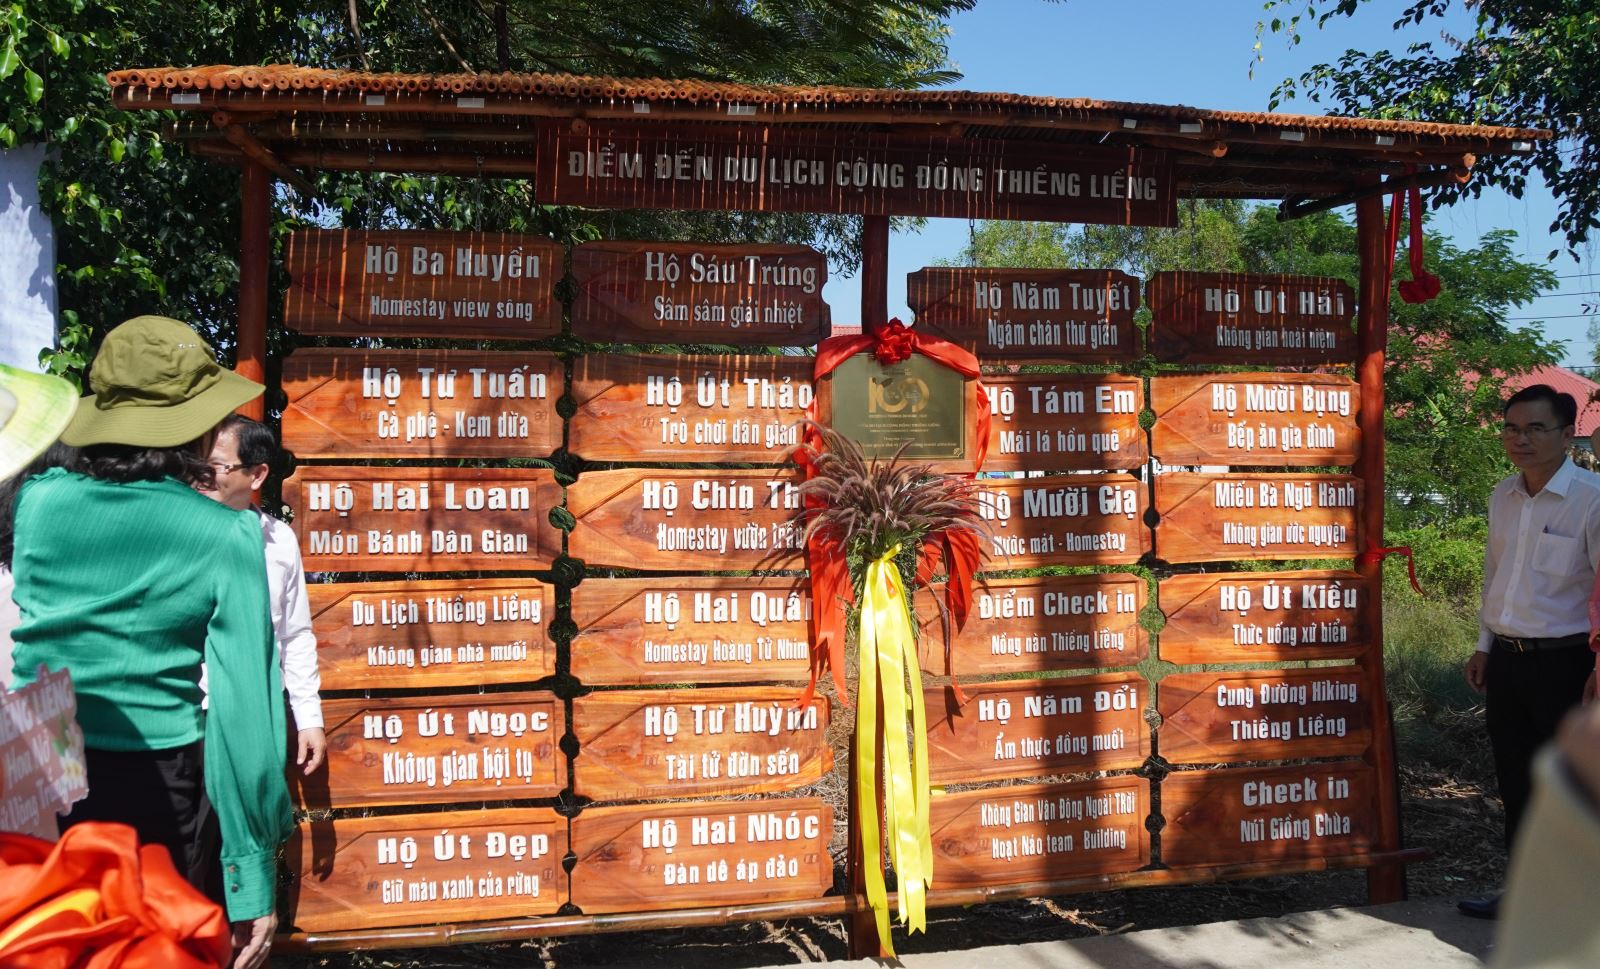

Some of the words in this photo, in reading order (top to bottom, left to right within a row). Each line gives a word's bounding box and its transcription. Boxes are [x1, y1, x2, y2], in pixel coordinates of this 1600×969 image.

[569, 144, 643, 179] ĐIỂM
[655, 148, 713, 181] ĐẾN
[724, 155, 757, 184] DU
[769, 158, 825, 186] LỊCH
[835, 158, 904, 194] CỘNG
[916, 158, 984, 193] ĐỒNG
[997, 164, 1081, 198] THIỀNG
[1090, 170, 1157, 201] LIỀNG
[366, 246, 398, 281] Hộ
[413, 247, 444, 276] Ba
[457, 247, 539, 282] Huyền
[645, 251, 680, 288] Hộ
[690, 253, 735, 284] Sáu
[745, 256, 816, 294] Trúng
[371, 296, 446, 320] Homestay
[453, 298, 490, 318] view
[497, 299, 533, 321] sông
[654, 296, 688, 321] Sâm
[694, 299, 725, 321] sâm
[764, 299, 802, 328] nhiệt
[975, 281, 1001, 315] Hộ
[1012, 282, 1060, 310] Năm
[1069, 279, 1131, 314] Tuyết
[1205, 288, 1239, 318] Hộ
[988, 318, 1024, 349] Ngâm
[1030, 319, 1060, 345] chân
[1067, 321, 1086, 345] thư
[1217, 326, 1251, 349] Không
[1256, 329, 1277, 349] gian
[363, 368, 401, 405] Hộ
[418, 368, 457, 398] Tư
[469, 365, 546, 399] Tuấn
[647, 375, 682, 412] Hộ
[698, 371, 730, 407] Út
[744, 375, 813, 409] Thảo
[1213, 384, 1237, 417] Hộ
[1246, 384, 1294, 412] Mười
[1303, 385, 1349, 417] Bụng
[985, 386, 1014, 421] Hộ
[1028, 386, 1084, 414] Tám
[1096, 386, 1135, 414] Em
[379, 411, 398, 438] Cà
[407, 413, 437, 442] phê
[456, 412, 491, 437] Kem
[498, 411, 528, 438] dừa
[660, 417, 687, 444] Trò
[732, 420, 759, 444] dân
[765, 420, 796, 448] gian
[1000, 430, 1030, 454] Mái
[1037, 430, 1054, 453] lá
[1058, 427, 1085, 452] hồn
[1092, 430, 1119, 454] quê
[1228, 420, 1254, 449] Bếp
[1260, 424, 1276, 448] ăn
[1282, 424, 1301, 452] gia
[309, 484, 354, 516] Hộ
[372, 483, 429, 511] Hai
[445, 484, 529, 511] Loan
[643, 480, 678, 516] Hộ
[692, 480, 753, 509] Chín
[1024, 487, 1088, 518] Mười
[1216, 480, 1253, 507] Miếu
[1259, 483, 1277, 507] Bà
[1284, 482, 1312, 510] Ngũ
[1319, 482, 1354, 507] Hành
[310, 531, 358, 554] Món
[368, 530, 422, 554] Bánh
[432, 530, 472, 553] Dân
[482, 530, 527, 553] Gian
[657, 523, 727, 553] Homestay
[1067, 531, 1125, 552] Homestay
[1223, 522, 1257, 547] Không
[1260, 522, 1282, 547] gian
[645, 593, 679, 630] Hộ
[695, 593, 737, 622] Hai
[979, 589, 1034, 619] Điểm
[1044, 591, 1108, 616] Check
[1117, 591, 1135, 613] in
[1220, 586, 1250, 616] Hộ
[1263, 579, 1291, 610] Út
[1302, 581, 1356, 609] Kiều
[382, 600, 418, 629] Lịch
[1268, 622, 1297, 646] uống
[421, 645, 451, 666] gian
[644, 640, 707, 665] Homestay
[979, 699, 1011, 724] Hộ
[1024, 696, 1082, 718] Năm
[1094, 685, 1137, 712] Đổi
[1217, 684, 1254, 708] Cung
[1261, 683, 1307, 706] Đường
[1312, 680, 1357, 702] Hiking
[364, 715, 403, 743] Hộ
[418, 709, 454, 737] Út
[468, 710, 548, 736] Ngọc
[645, 707, 678, 742] Hộ
[691, 705, 725, 735] Tư
[1231, 715, 1291, 741] Thiềng
[1299, 713, 1346, 737] Liềng
[1021, 738, 1050, 760] thực
[1056, 732, 1087, 755] đồng
[443, 750, 478, 785] gian
[483, 748, 509, 785] hội
[516, 749, 532, 783] tụ
[666, 755, 694, 780] Tài
[728, 753, 759, 777] đờn
[1243, 777, 1317, 806] Check
[1328, 777, 1349, 799] in
[1059, 798, 1082, 823] Động
[643, 819, 677, 853] Hộ
[692, 816, 735, 846] Hai
[748, 811, 819, 842] Nhóc
[1271, 813, 1310, 841] Giồng
[377, 837, 418, 868] Hộ
[434, 830, 471, 861] Út
[486, 832, 548, 861] Đẹp
[992, 837, 1017, 861] Hoạt
[1047, 834, 1072, 853] team
[1084, 828, 1126, 849] Building
[707, 859, 728, 882] dê
[737, 859, 758, 882] áp
[442, 876, 473, 900] xanh
